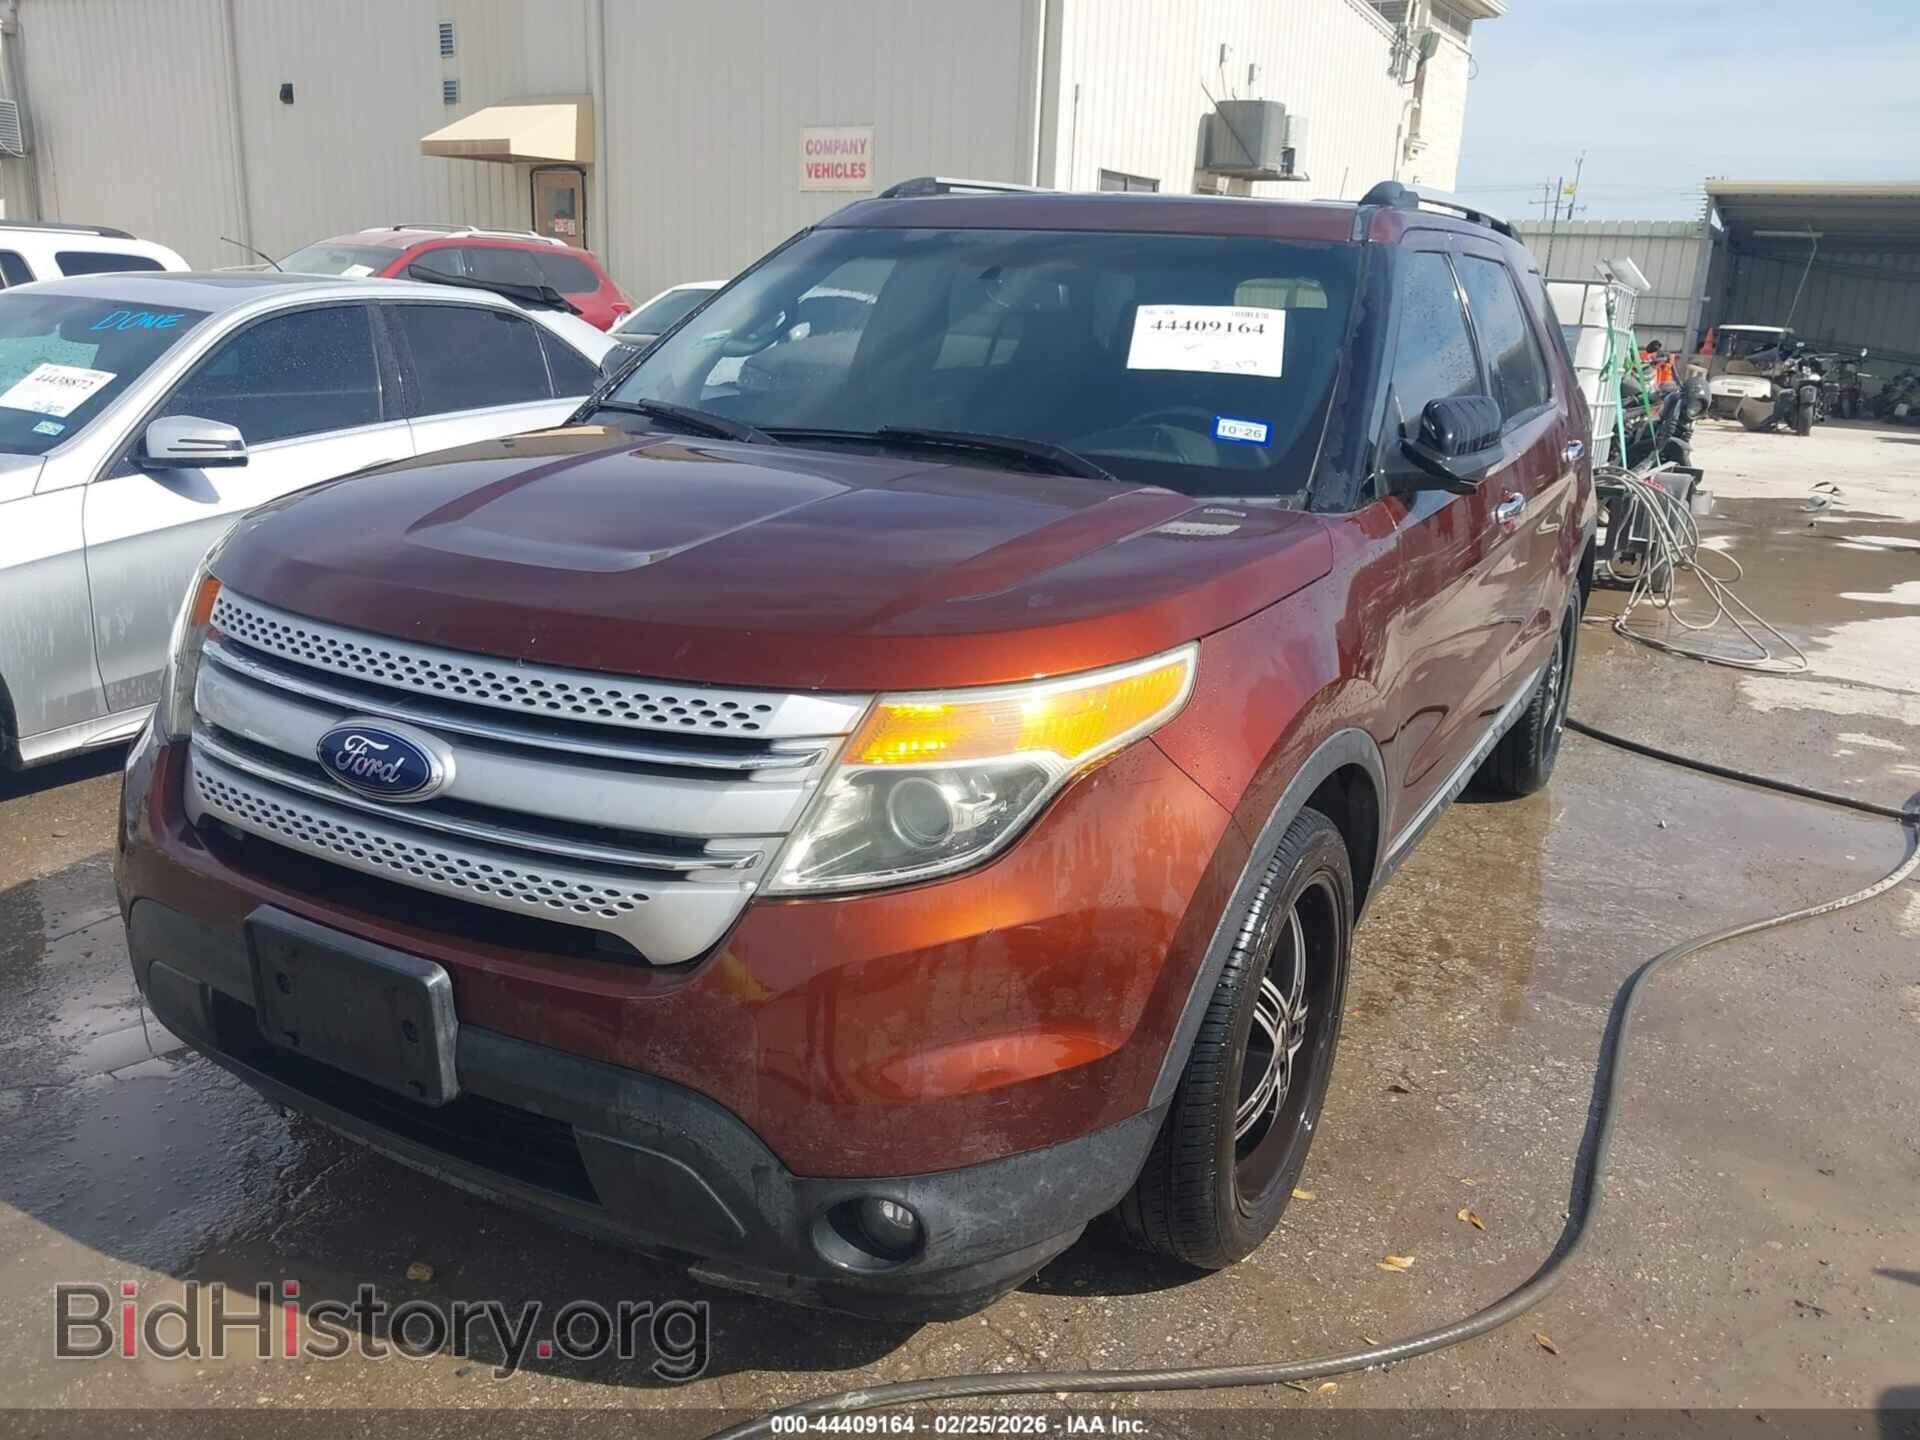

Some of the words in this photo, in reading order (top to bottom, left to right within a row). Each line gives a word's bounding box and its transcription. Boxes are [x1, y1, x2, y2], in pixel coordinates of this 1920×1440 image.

[806, 139, 867, 155] COMPANY
[806, 162, 867, 178] VEHICLES
[90, 311, 185, 330] DONE
[1150, 319, 1265, 335] 44409164
[335, 735, 405, 784] Ford
